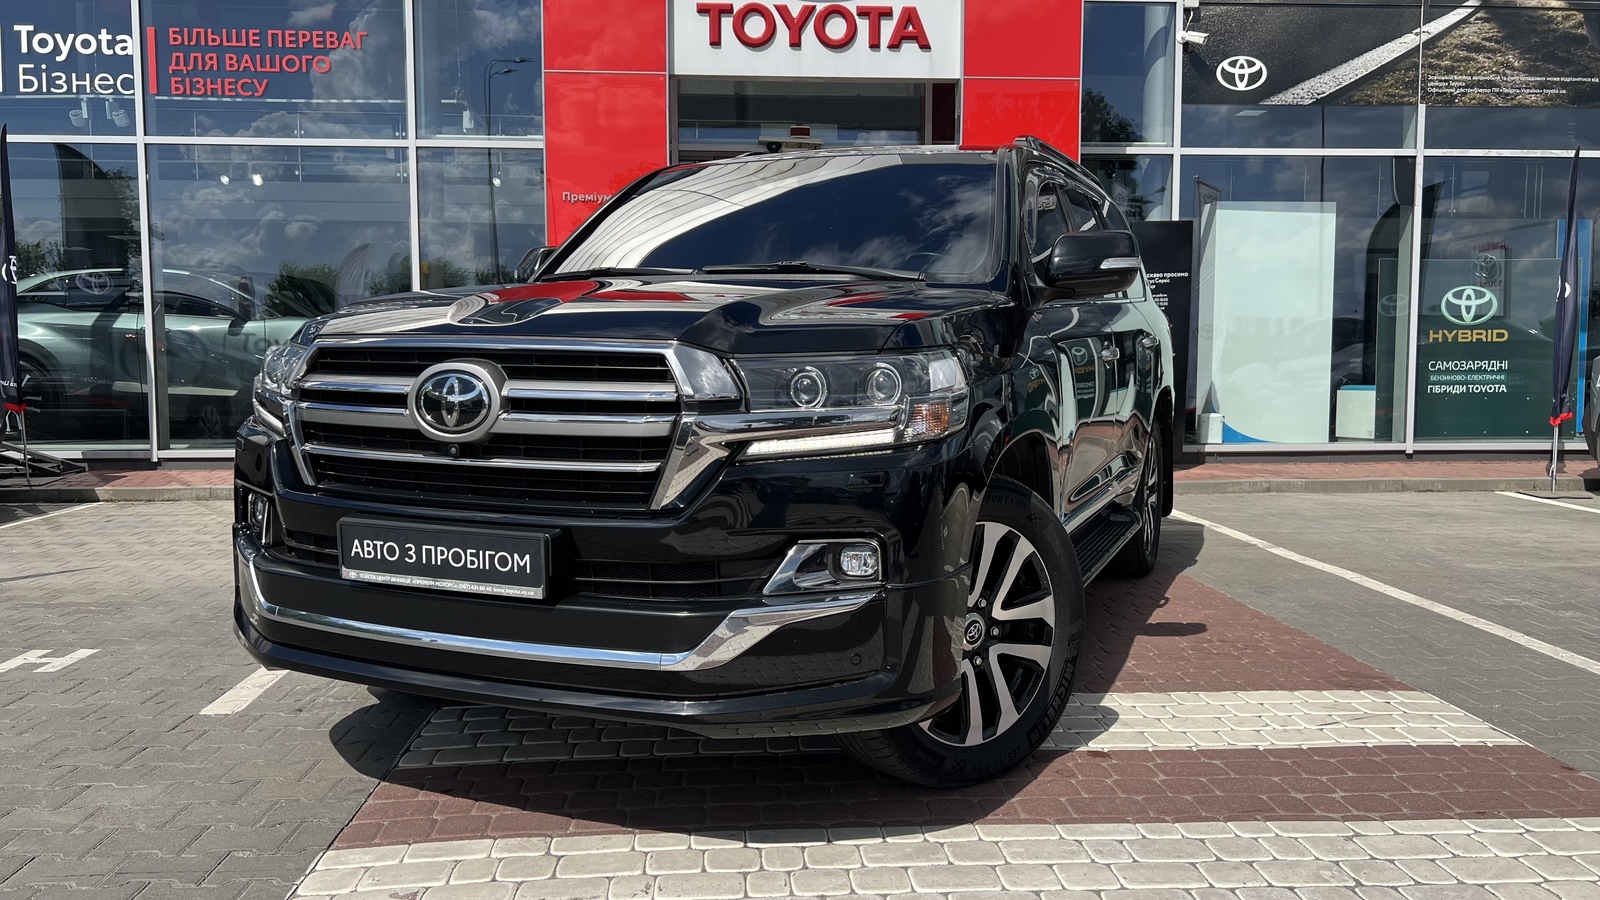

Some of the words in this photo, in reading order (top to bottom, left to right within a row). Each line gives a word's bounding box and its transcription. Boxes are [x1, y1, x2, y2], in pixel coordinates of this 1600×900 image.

[696, 3, 931, 50] TOYOTA
[13, 24, 134, 62] Toyota
[168, 27, 261, 48] БІЛЬШЕ
[267, 29, 368, 50] ПЕРЕВАГ
[168, 52, 218, 74] ДЛЯ
[225, 54, 332, 74] ВАШОГО
[18, 63, 135, 95] Бізнес
[170, 77, 269, 98] БІЗНЕСУ
[1429, 329, 1509, 342] HYBRID
[1428, 360, 1508, 371] САМОЗАРЯДНІ
[1427, 384, 1466, 395] ГІБРИДИ
[1467, 384, 1507, 393] TOYOTA
[350, 538, 400, 562] АВТО
[421, 545, 531, 574] ПРОБІГОМ
[1029, 661, 1075, 745] MICHELIN
